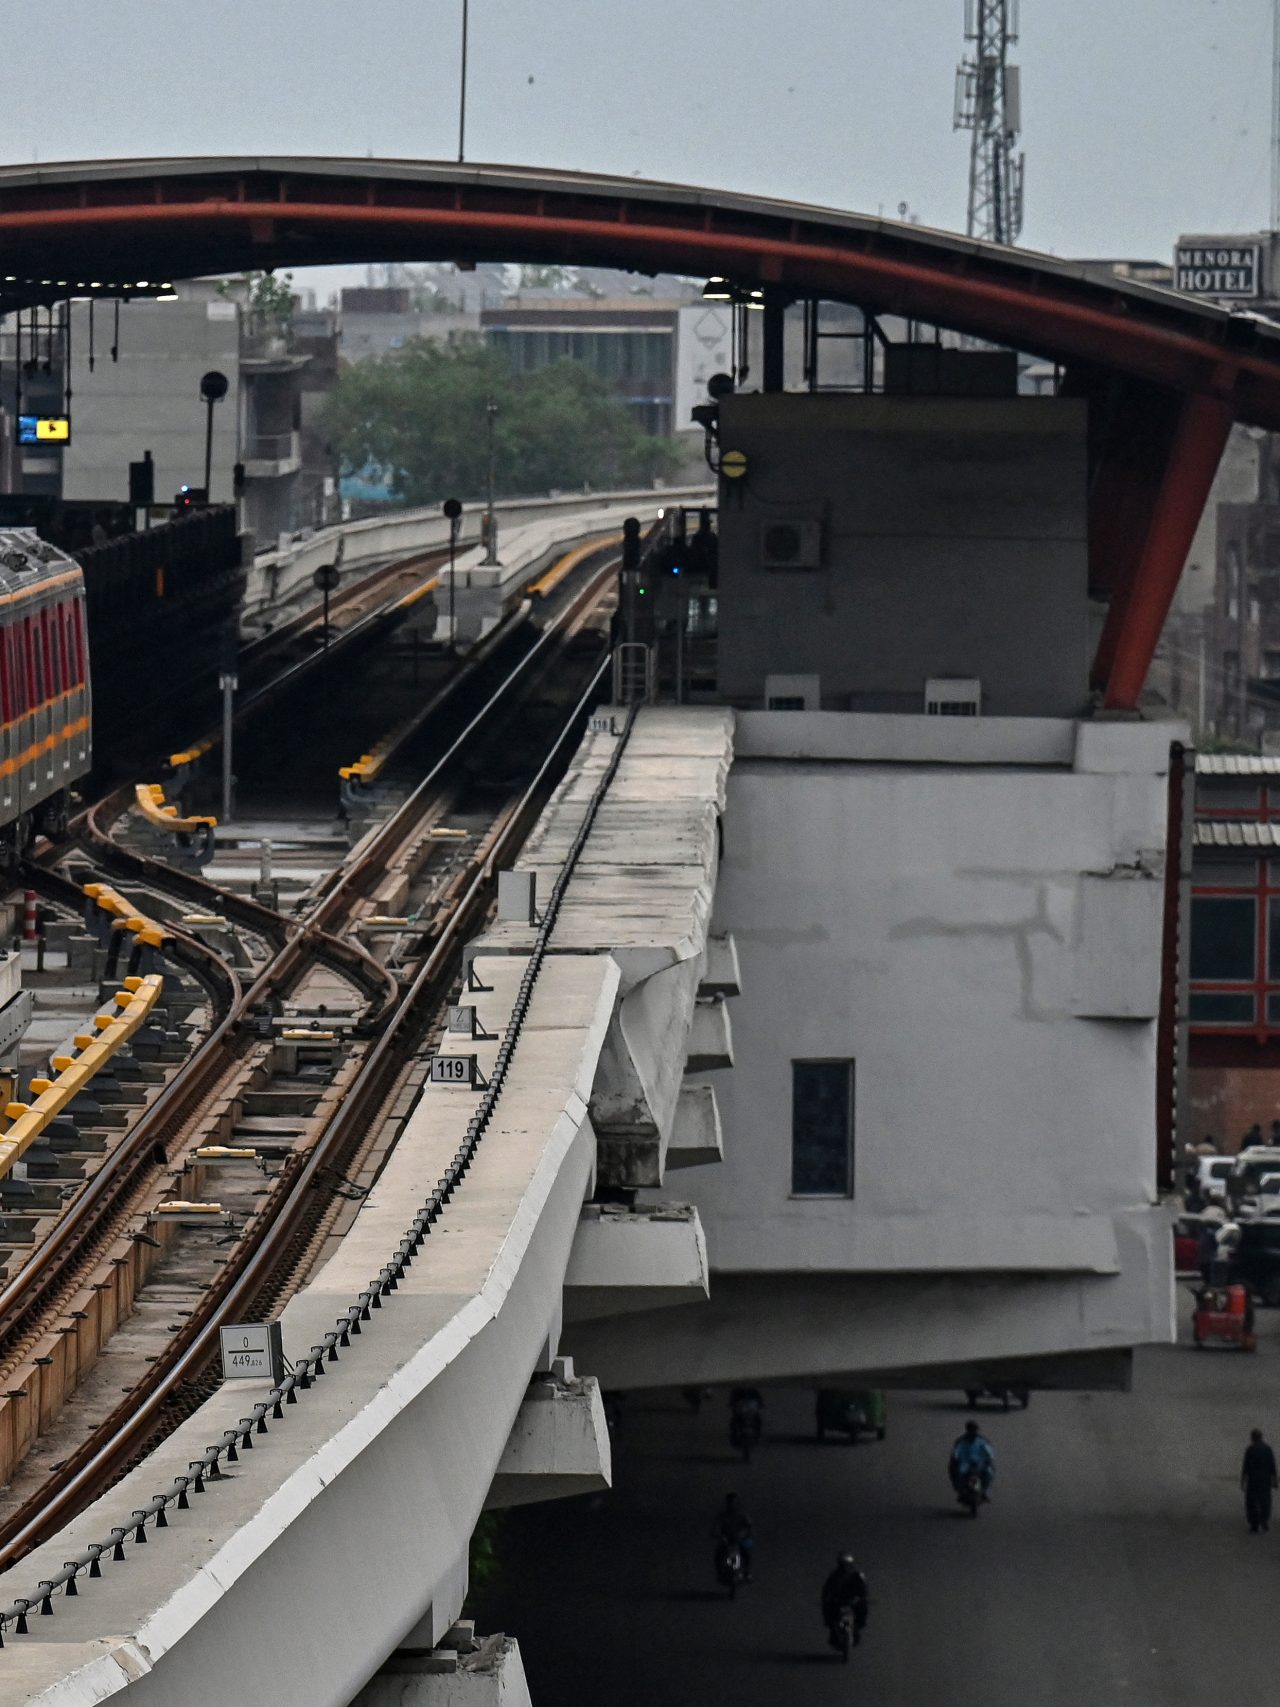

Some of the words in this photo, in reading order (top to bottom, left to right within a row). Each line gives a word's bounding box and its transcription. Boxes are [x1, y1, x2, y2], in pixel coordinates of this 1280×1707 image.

[1179, 250, 1252, 267] MENORA
[1180, 269, 1252, 290] HOTEL
[437, 1060, 464, 1078] 119
